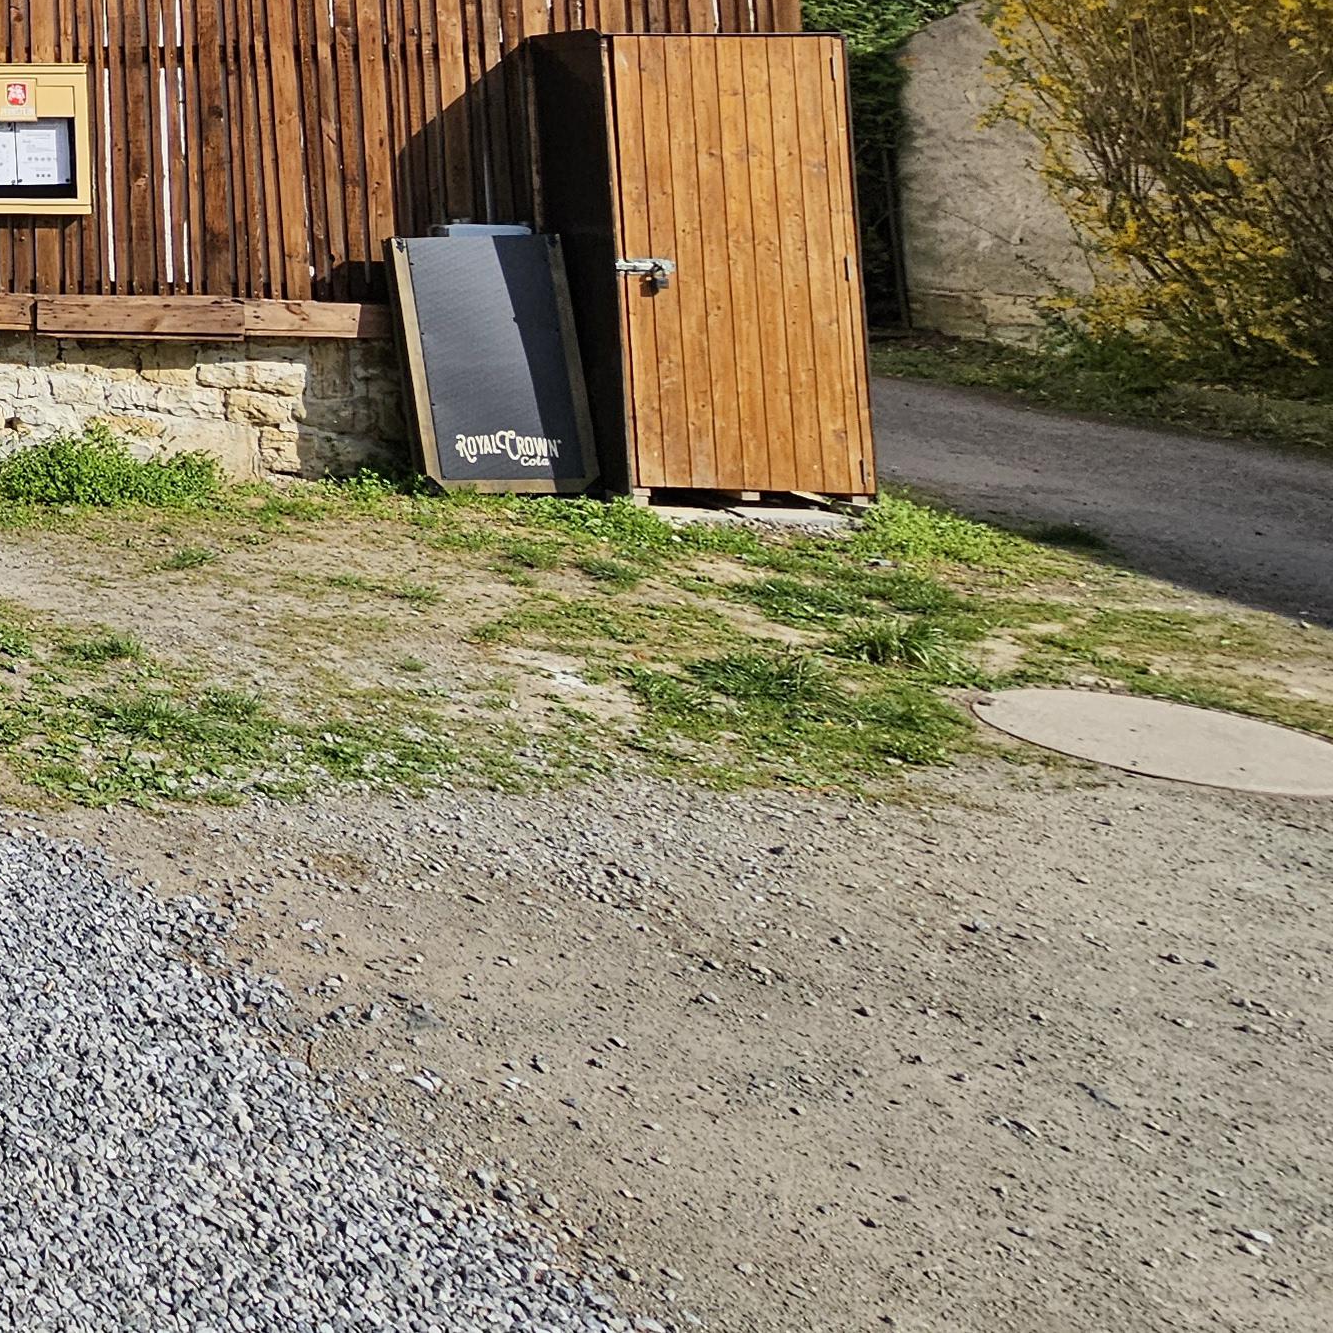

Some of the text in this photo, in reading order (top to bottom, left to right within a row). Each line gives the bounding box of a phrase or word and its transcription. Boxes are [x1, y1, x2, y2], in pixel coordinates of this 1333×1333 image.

[455, 430, 560, 463] ROYAL CROWN
[520, 455, 550, 466] Cola
